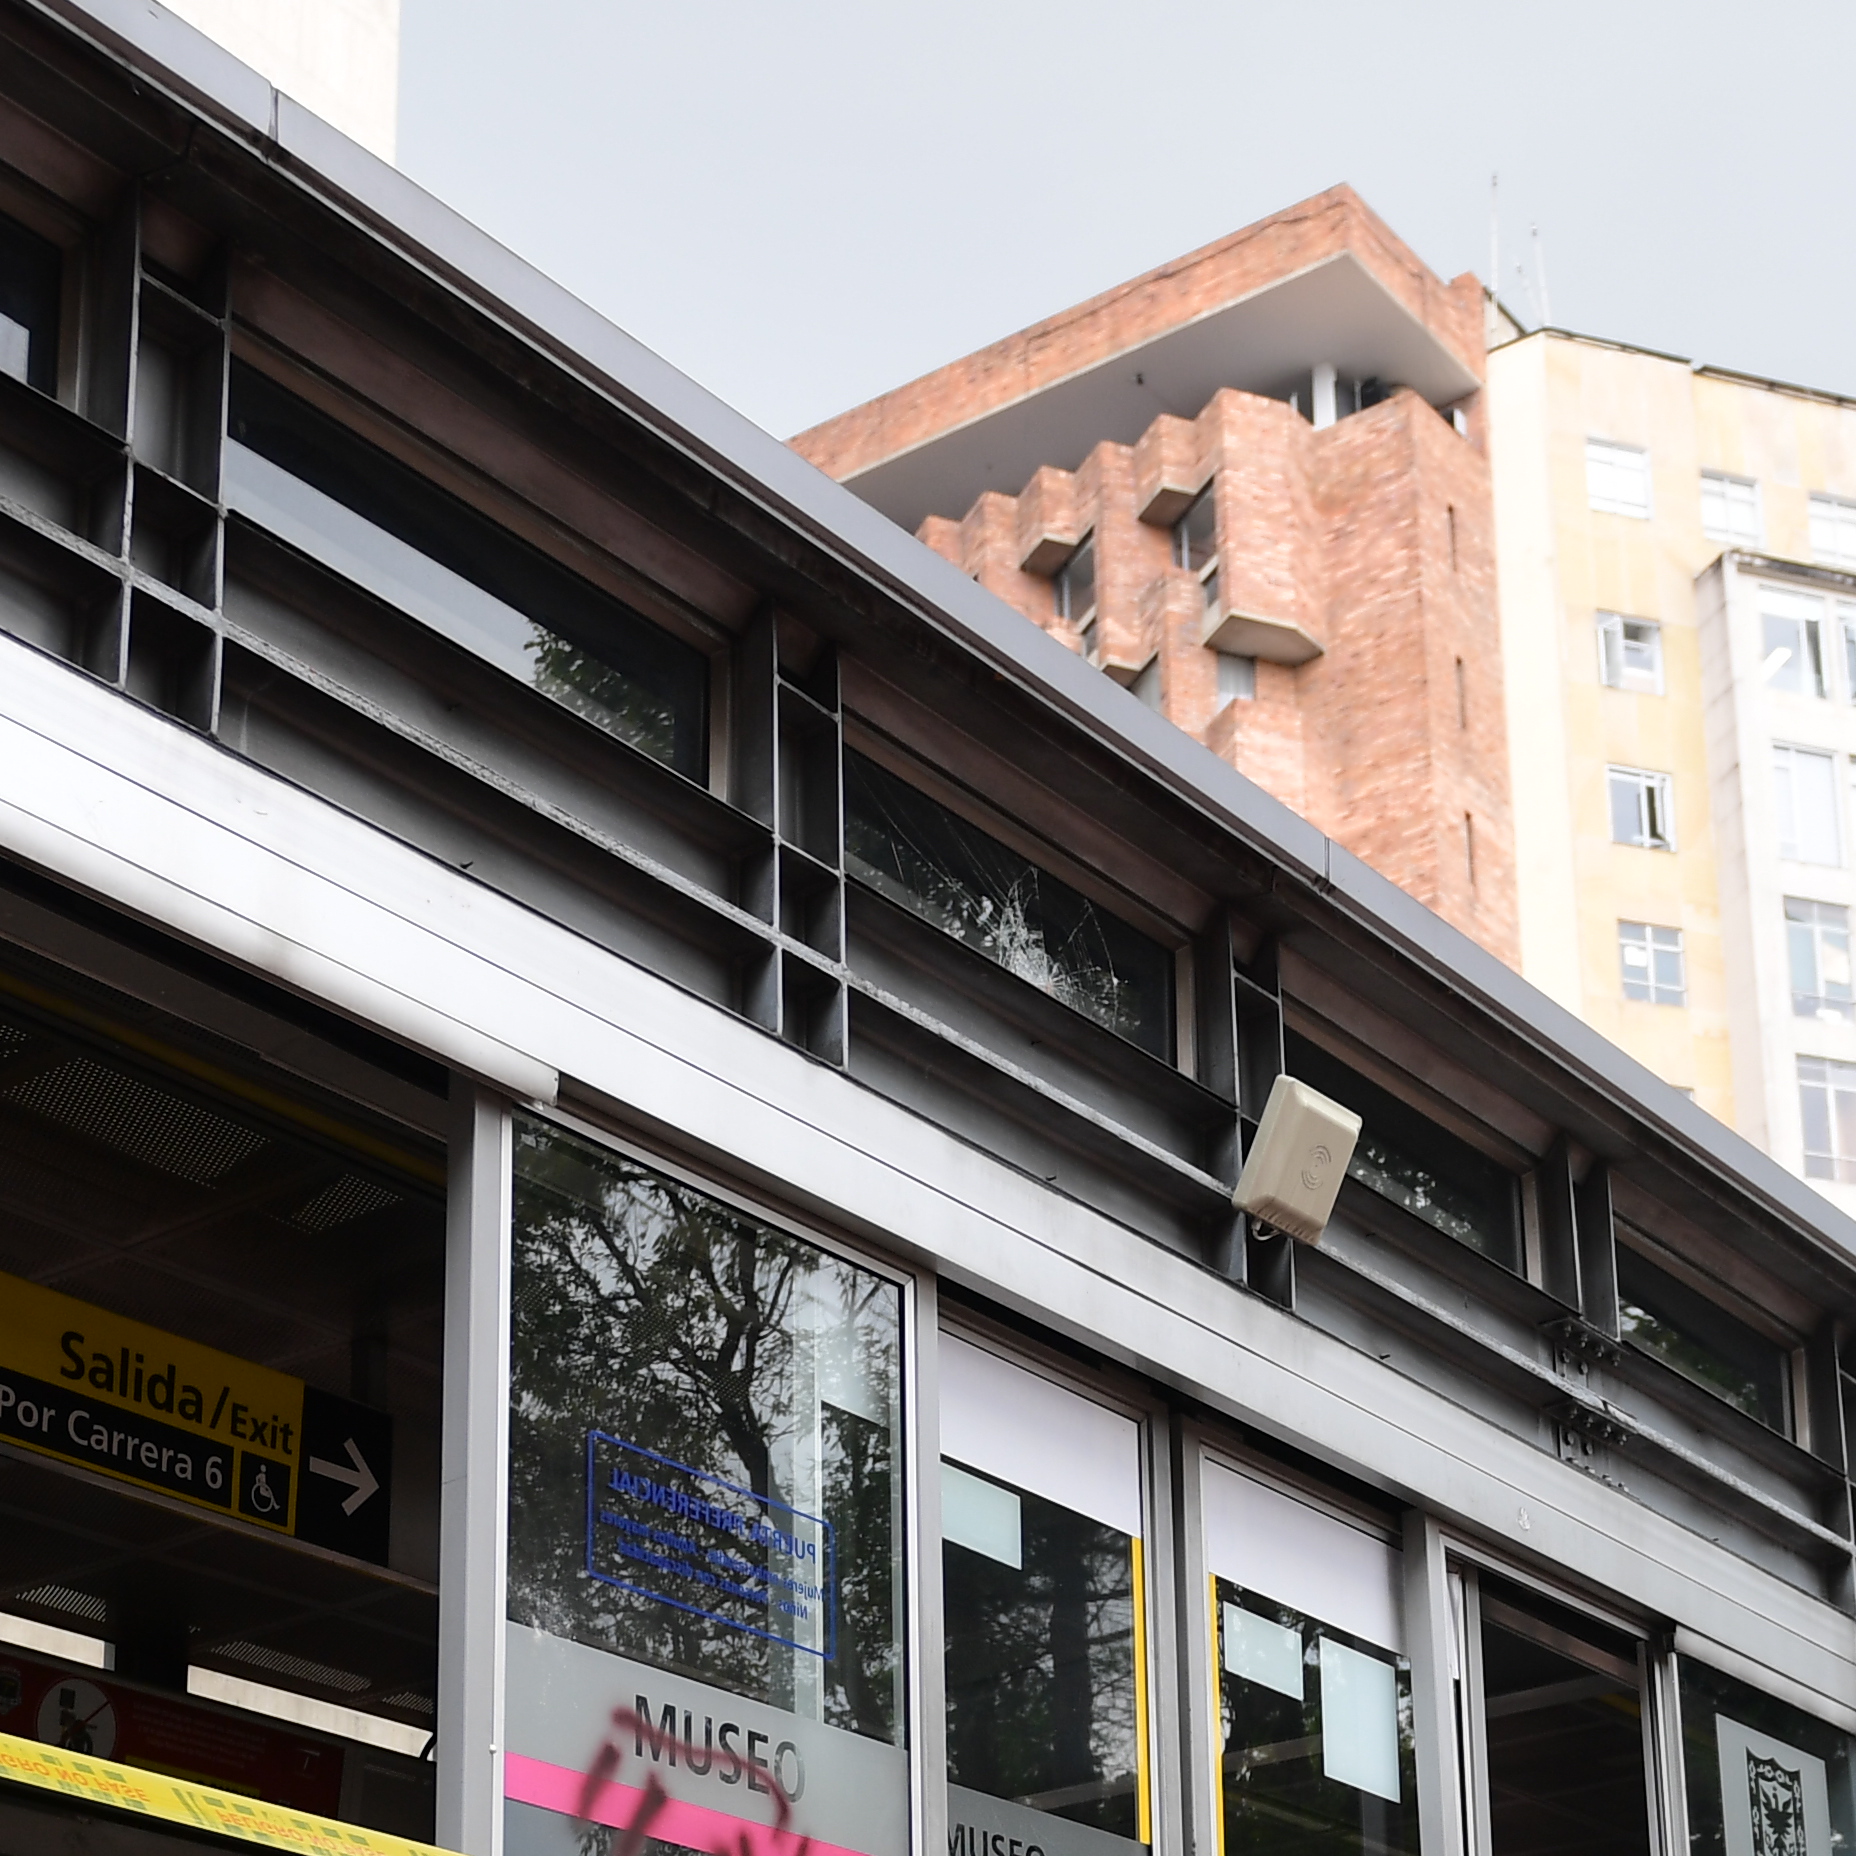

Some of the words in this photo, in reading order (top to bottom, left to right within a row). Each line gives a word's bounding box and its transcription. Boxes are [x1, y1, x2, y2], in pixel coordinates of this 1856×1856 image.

[60, 1331, 294, 1455] Salida/Exit
[67, 1410, 193, 1480] Carrera
[205, 1456, 224, 1489] 6
[633, 1694, 806, 1803] MUSEO
